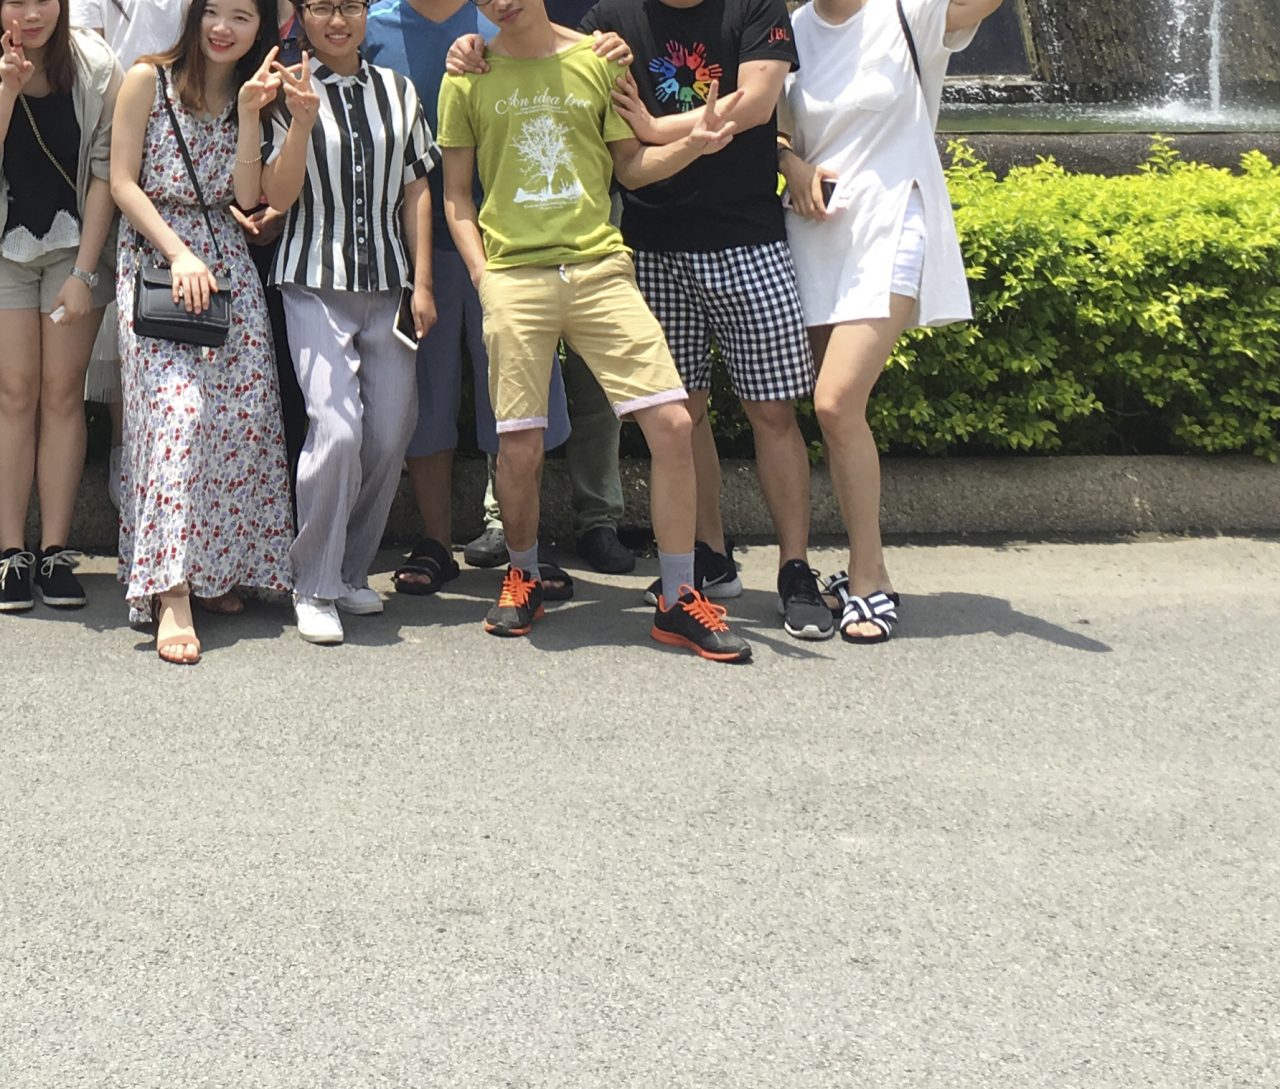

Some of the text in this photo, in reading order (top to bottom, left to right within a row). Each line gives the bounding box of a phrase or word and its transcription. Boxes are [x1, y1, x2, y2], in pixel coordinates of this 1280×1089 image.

[768, 27, 791, 44] JBL
[494, 87, 529, 115] An
[533, 87, 560, 105] idea
[564, 92, 592, 109] tree
